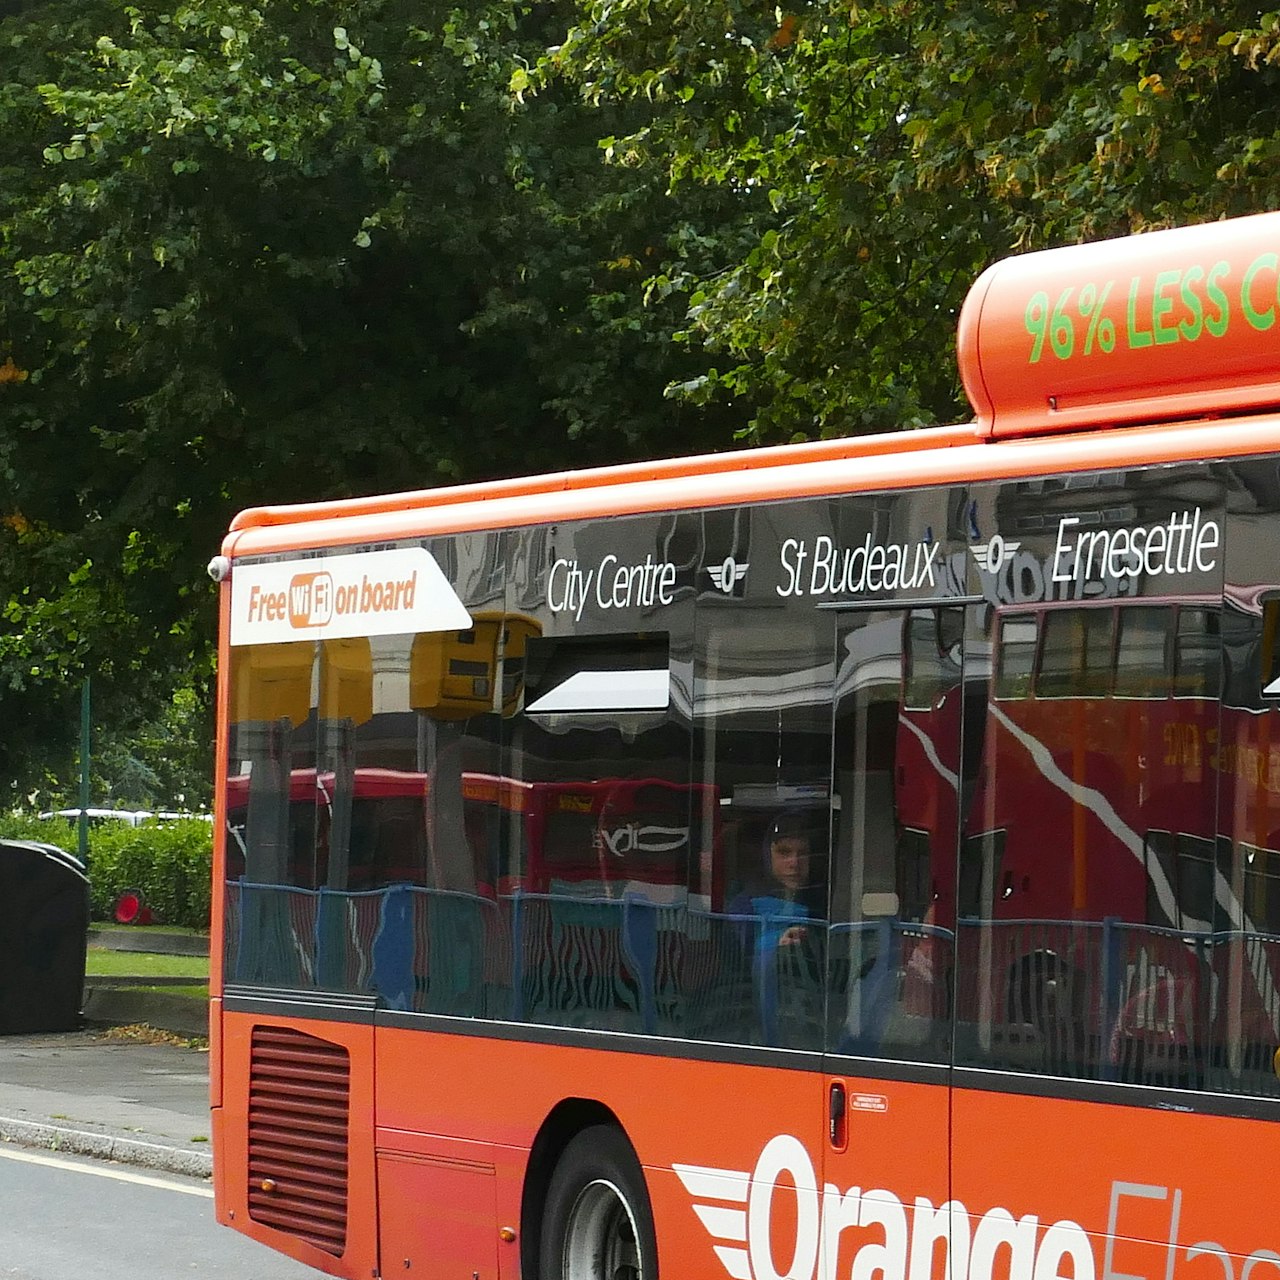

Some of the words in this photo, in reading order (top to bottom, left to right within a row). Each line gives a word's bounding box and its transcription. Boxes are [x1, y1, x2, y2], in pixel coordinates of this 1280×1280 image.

[1024, 280, 1115, 363] 96%
[1127, 260, 1230, 349] LESS
[777, 538, 807, 597] St
[811, 533, 940, 595] Budeaux
[1052, 507, 1219, 583] Ernesettle
[249, 586, 286, 622] Free
[335, 589, 357, 614] on
[360, 570, 417, 612] board
[548, 558, 594, 620] City
[598, 554, 676, 607] Centre
